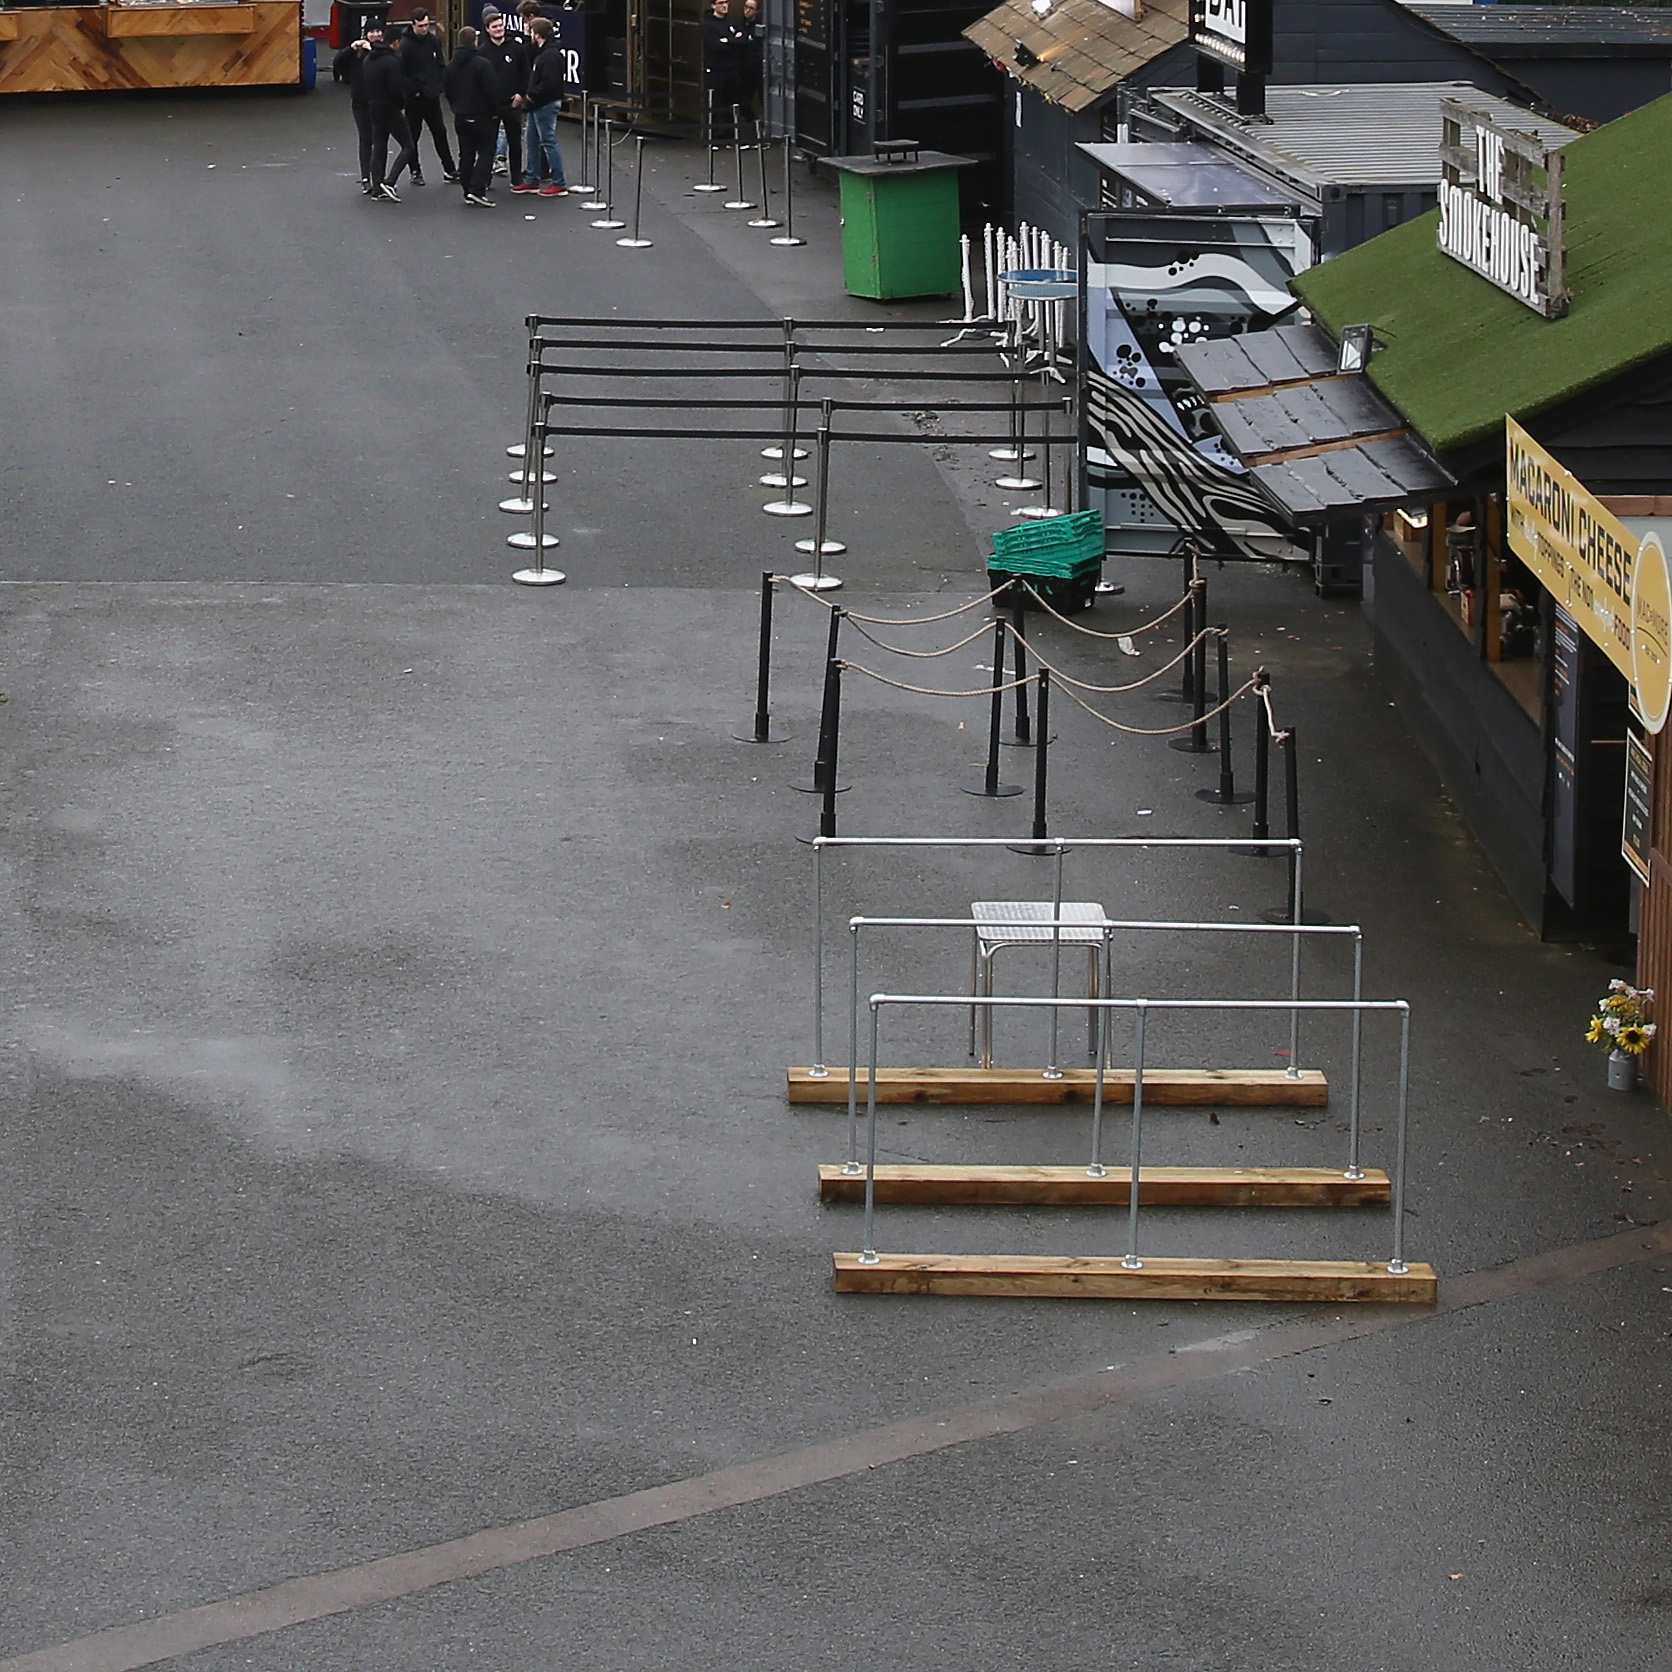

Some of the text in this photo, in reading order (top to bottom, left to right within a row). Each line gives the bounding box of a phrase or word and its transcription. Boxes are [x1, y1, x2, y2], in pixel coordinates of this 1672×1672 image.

[1476, 124, 1505, 205] THE
[1439, 178, 1540, 305] SMOKEHOUSE
[1510, 437, 1575, 548] MACARONI
[1578, 506, 1632, 607] CHEESE
